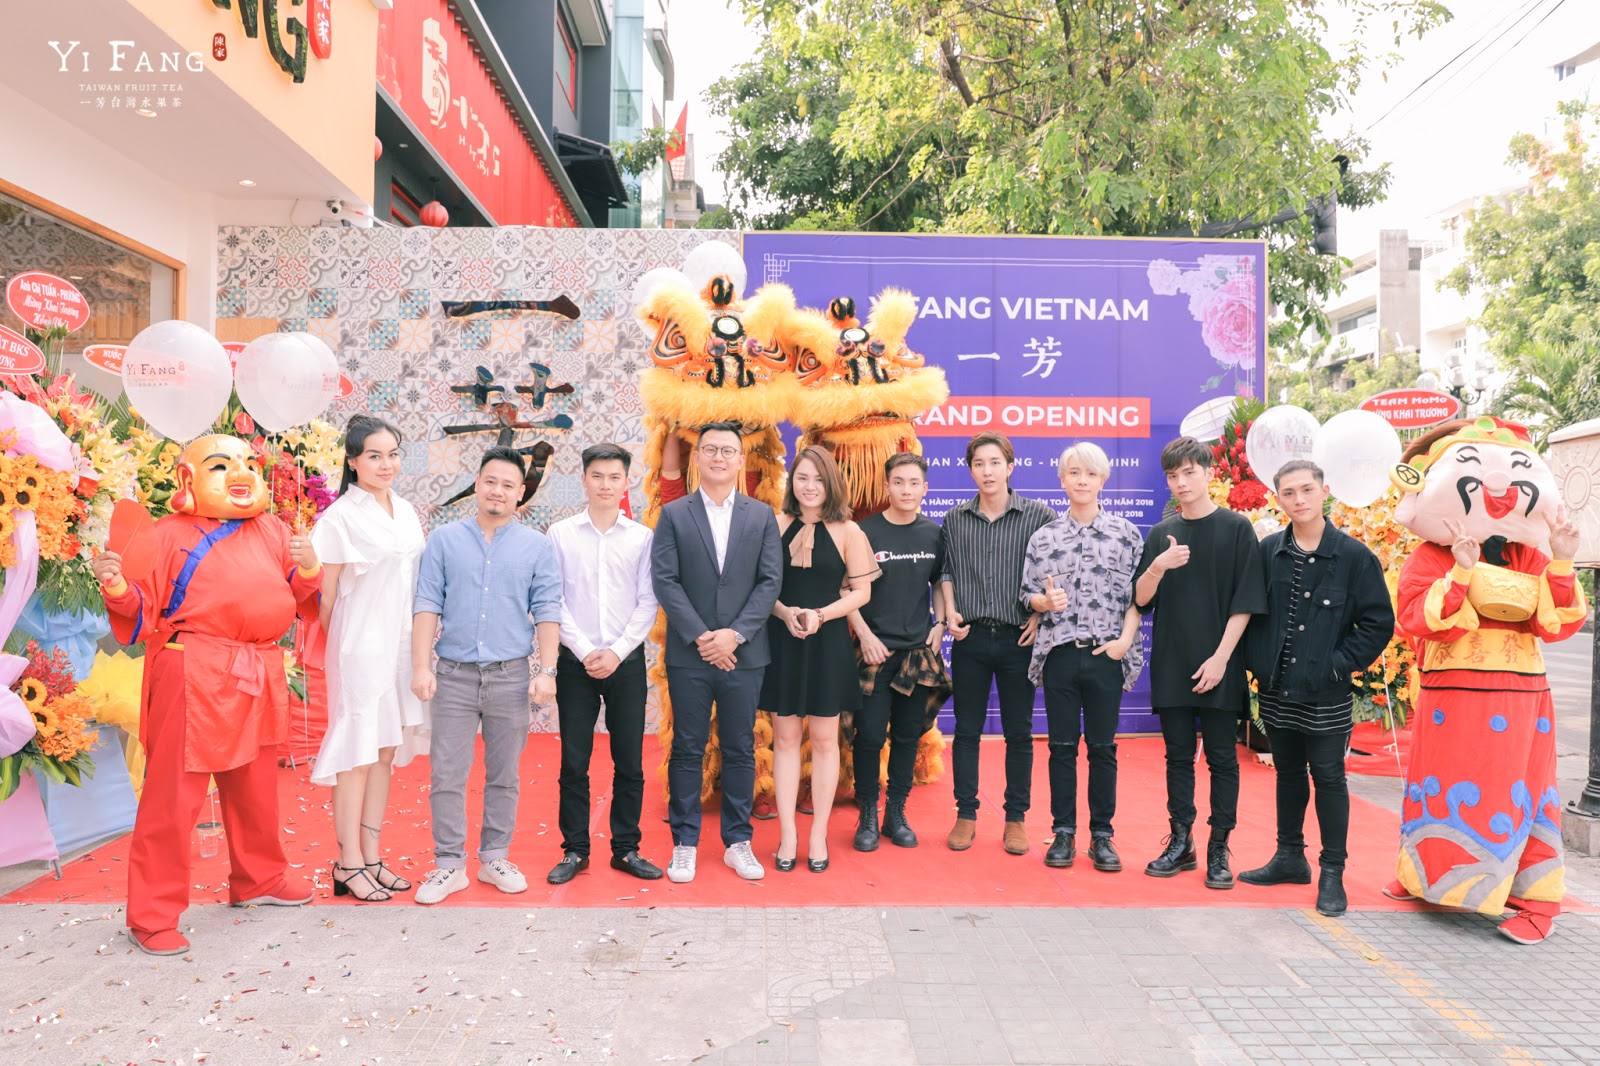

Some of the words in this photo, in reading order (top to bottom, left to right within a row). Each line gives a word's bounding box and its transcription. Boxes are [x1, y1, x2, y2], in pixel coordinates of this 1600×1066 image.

[1001, 296, 1149, 322] VIETNAM
[9, 341, 30, 357] BKS
[957, 335, 1063, 379] 一芳
[141, 364, 176, 375] FANG
[1372, 398, 1408, 407] TEAM
[1001, 405, 1140, 427] OPENING
[1394, 407, 1413, 420] KHAI
[925, 457, 951, 467] HAN
[1014, 457, 1032, 467] NG
[929, 497, 955, 506] HÀNG
[1114, 496, 1134, 506] NĂM
[1125, 510, 1144, 518] 2018
[874, 550, 936, 563] Champion
